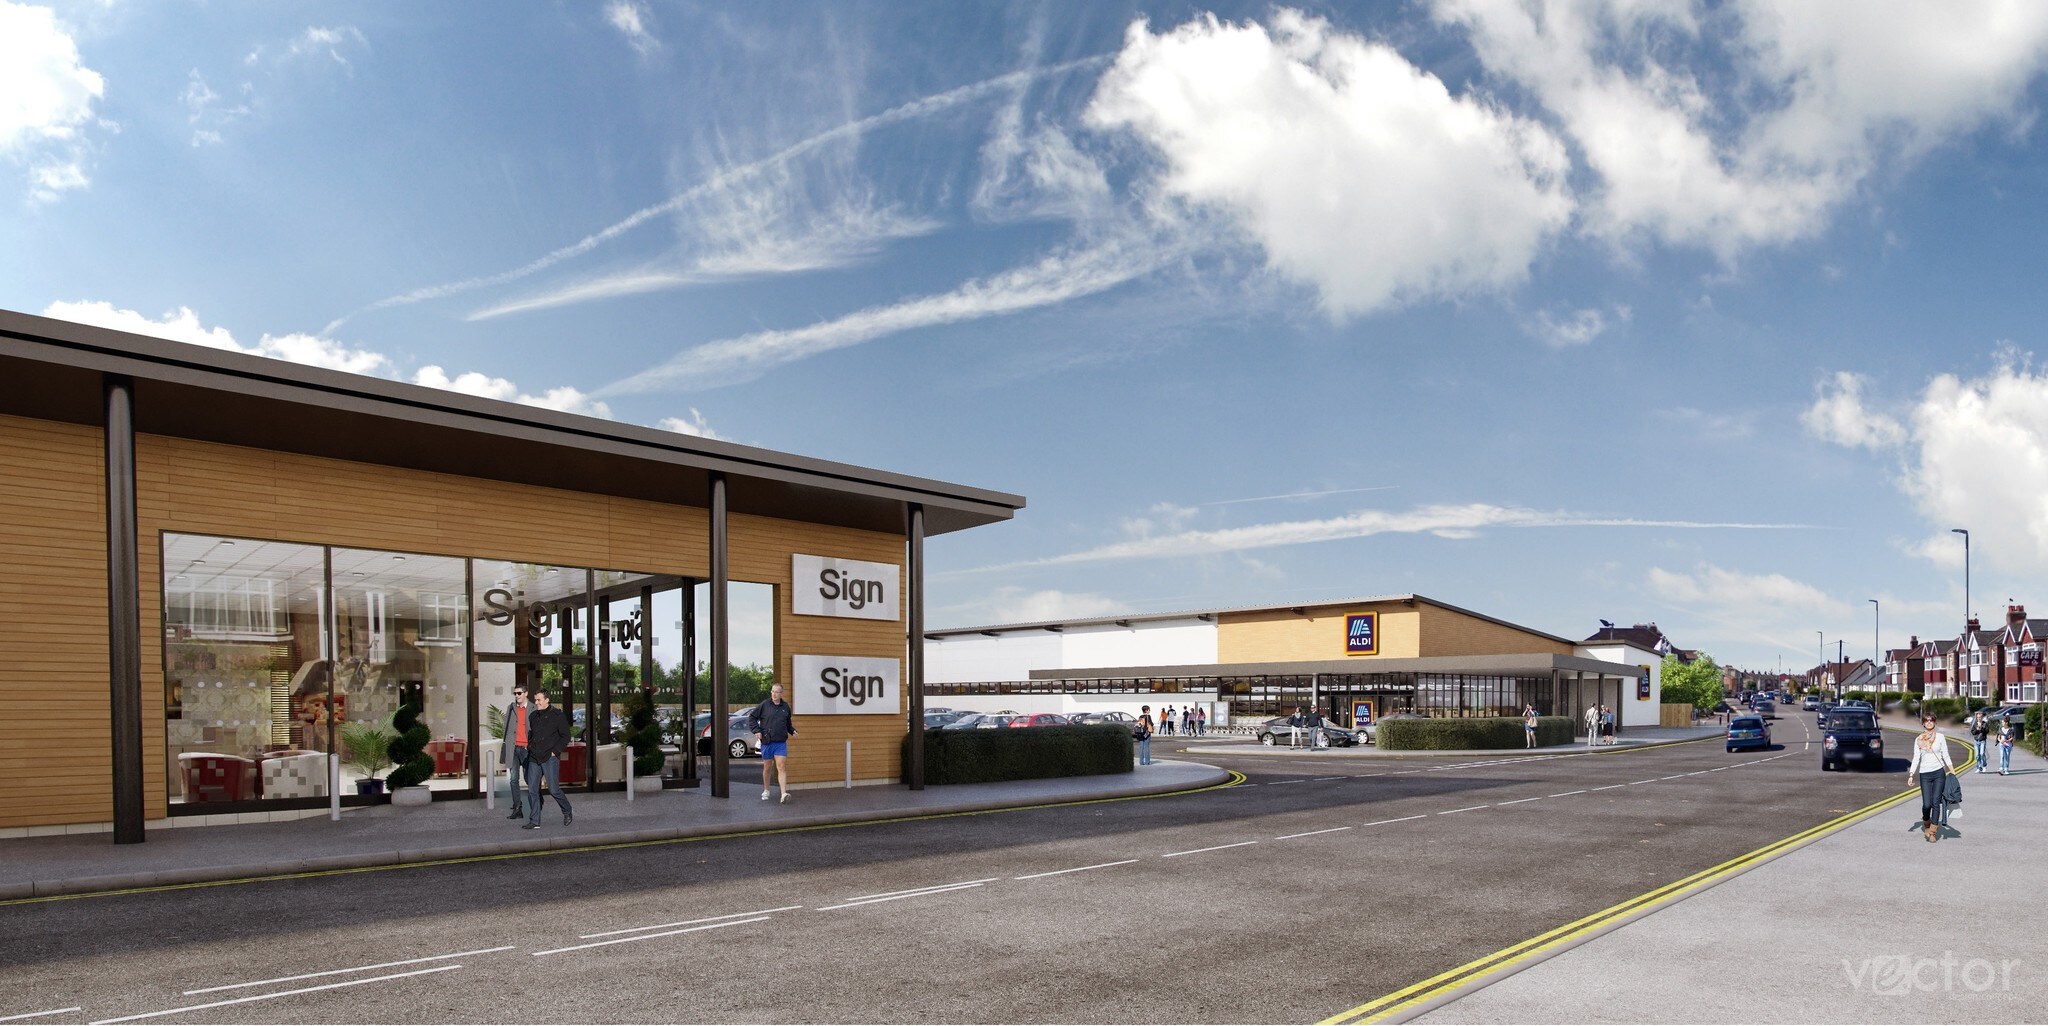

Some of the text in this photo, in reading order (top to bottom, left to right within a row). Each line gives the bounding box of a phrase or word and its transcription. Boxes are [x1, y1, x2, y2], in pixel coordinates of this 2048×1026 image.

[819, 568, 884, 610] Sign
[483, 588, 579, 638] Sign
[1349, 637, 1371, 646] ALDI
[2020, 651, 2039, 660] CAFE
[820, 667, 884, 706] Sign
